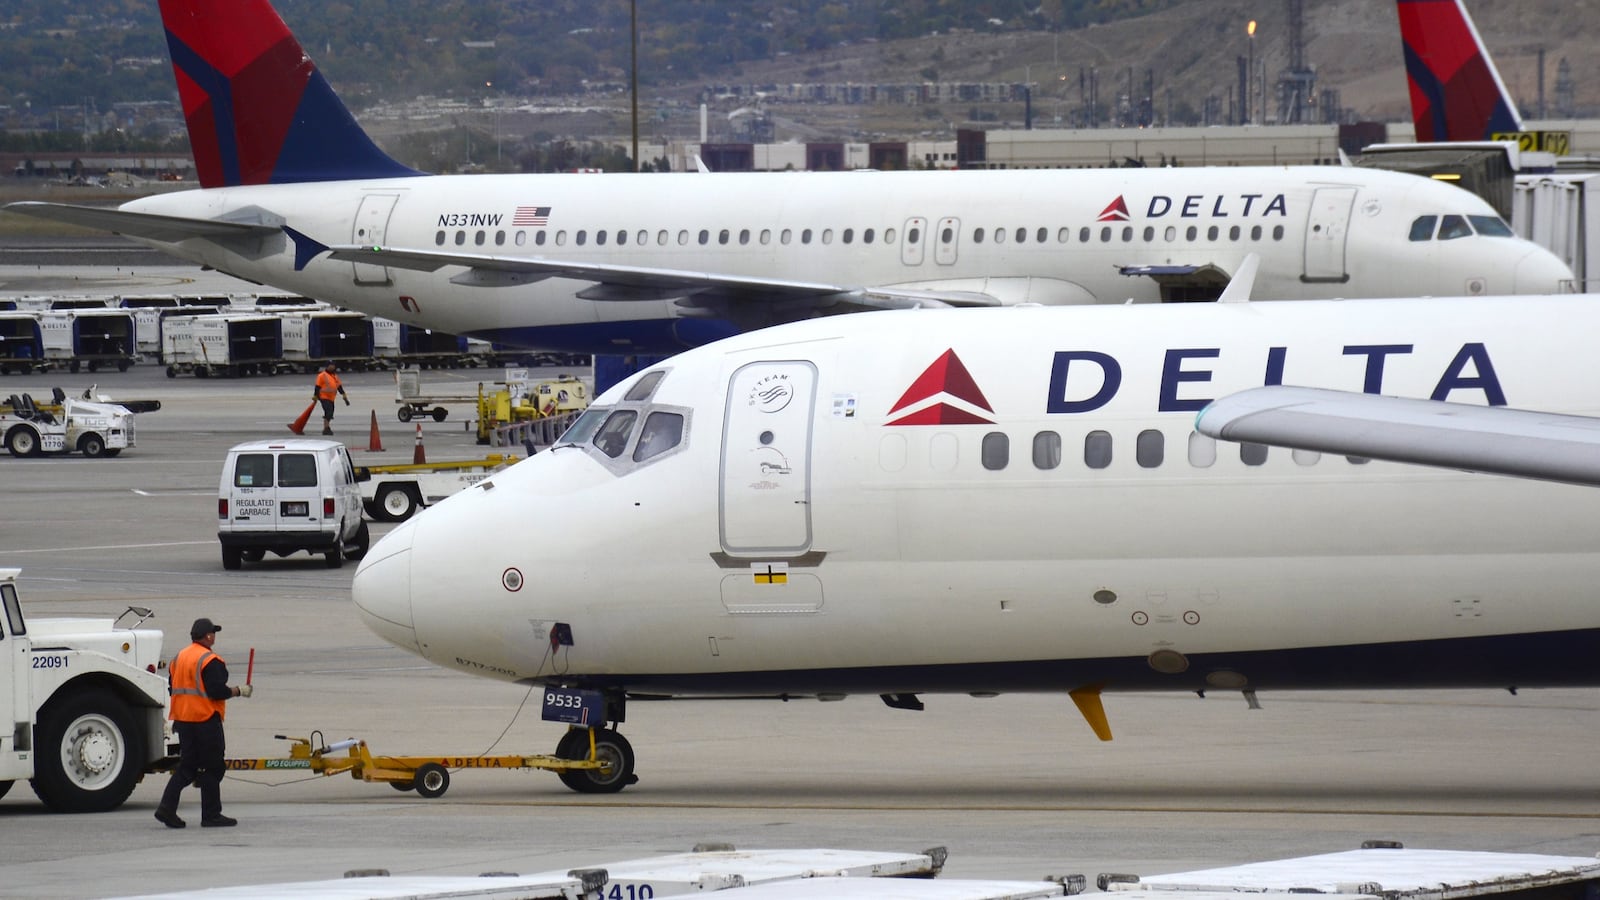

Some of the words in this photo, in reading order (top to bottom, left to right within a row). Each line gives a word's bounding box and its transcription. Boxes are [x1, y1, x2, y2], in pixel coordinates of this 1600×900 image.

[1146, 194, 1287, 218] DELTA
[438, 213, 503, 227] N331NW
[749, 374, 788, 406] SKYTEAM
[239, 508, 271, 516] GARBAGE
[32, 656, 68, 669] 22091
[546, 693, 582, 709] 9533
[225, 760, 257, 769] 7057
[280, 760, 310, 768] EQUIPPED
[455, 758, 500, 767] DELTA
